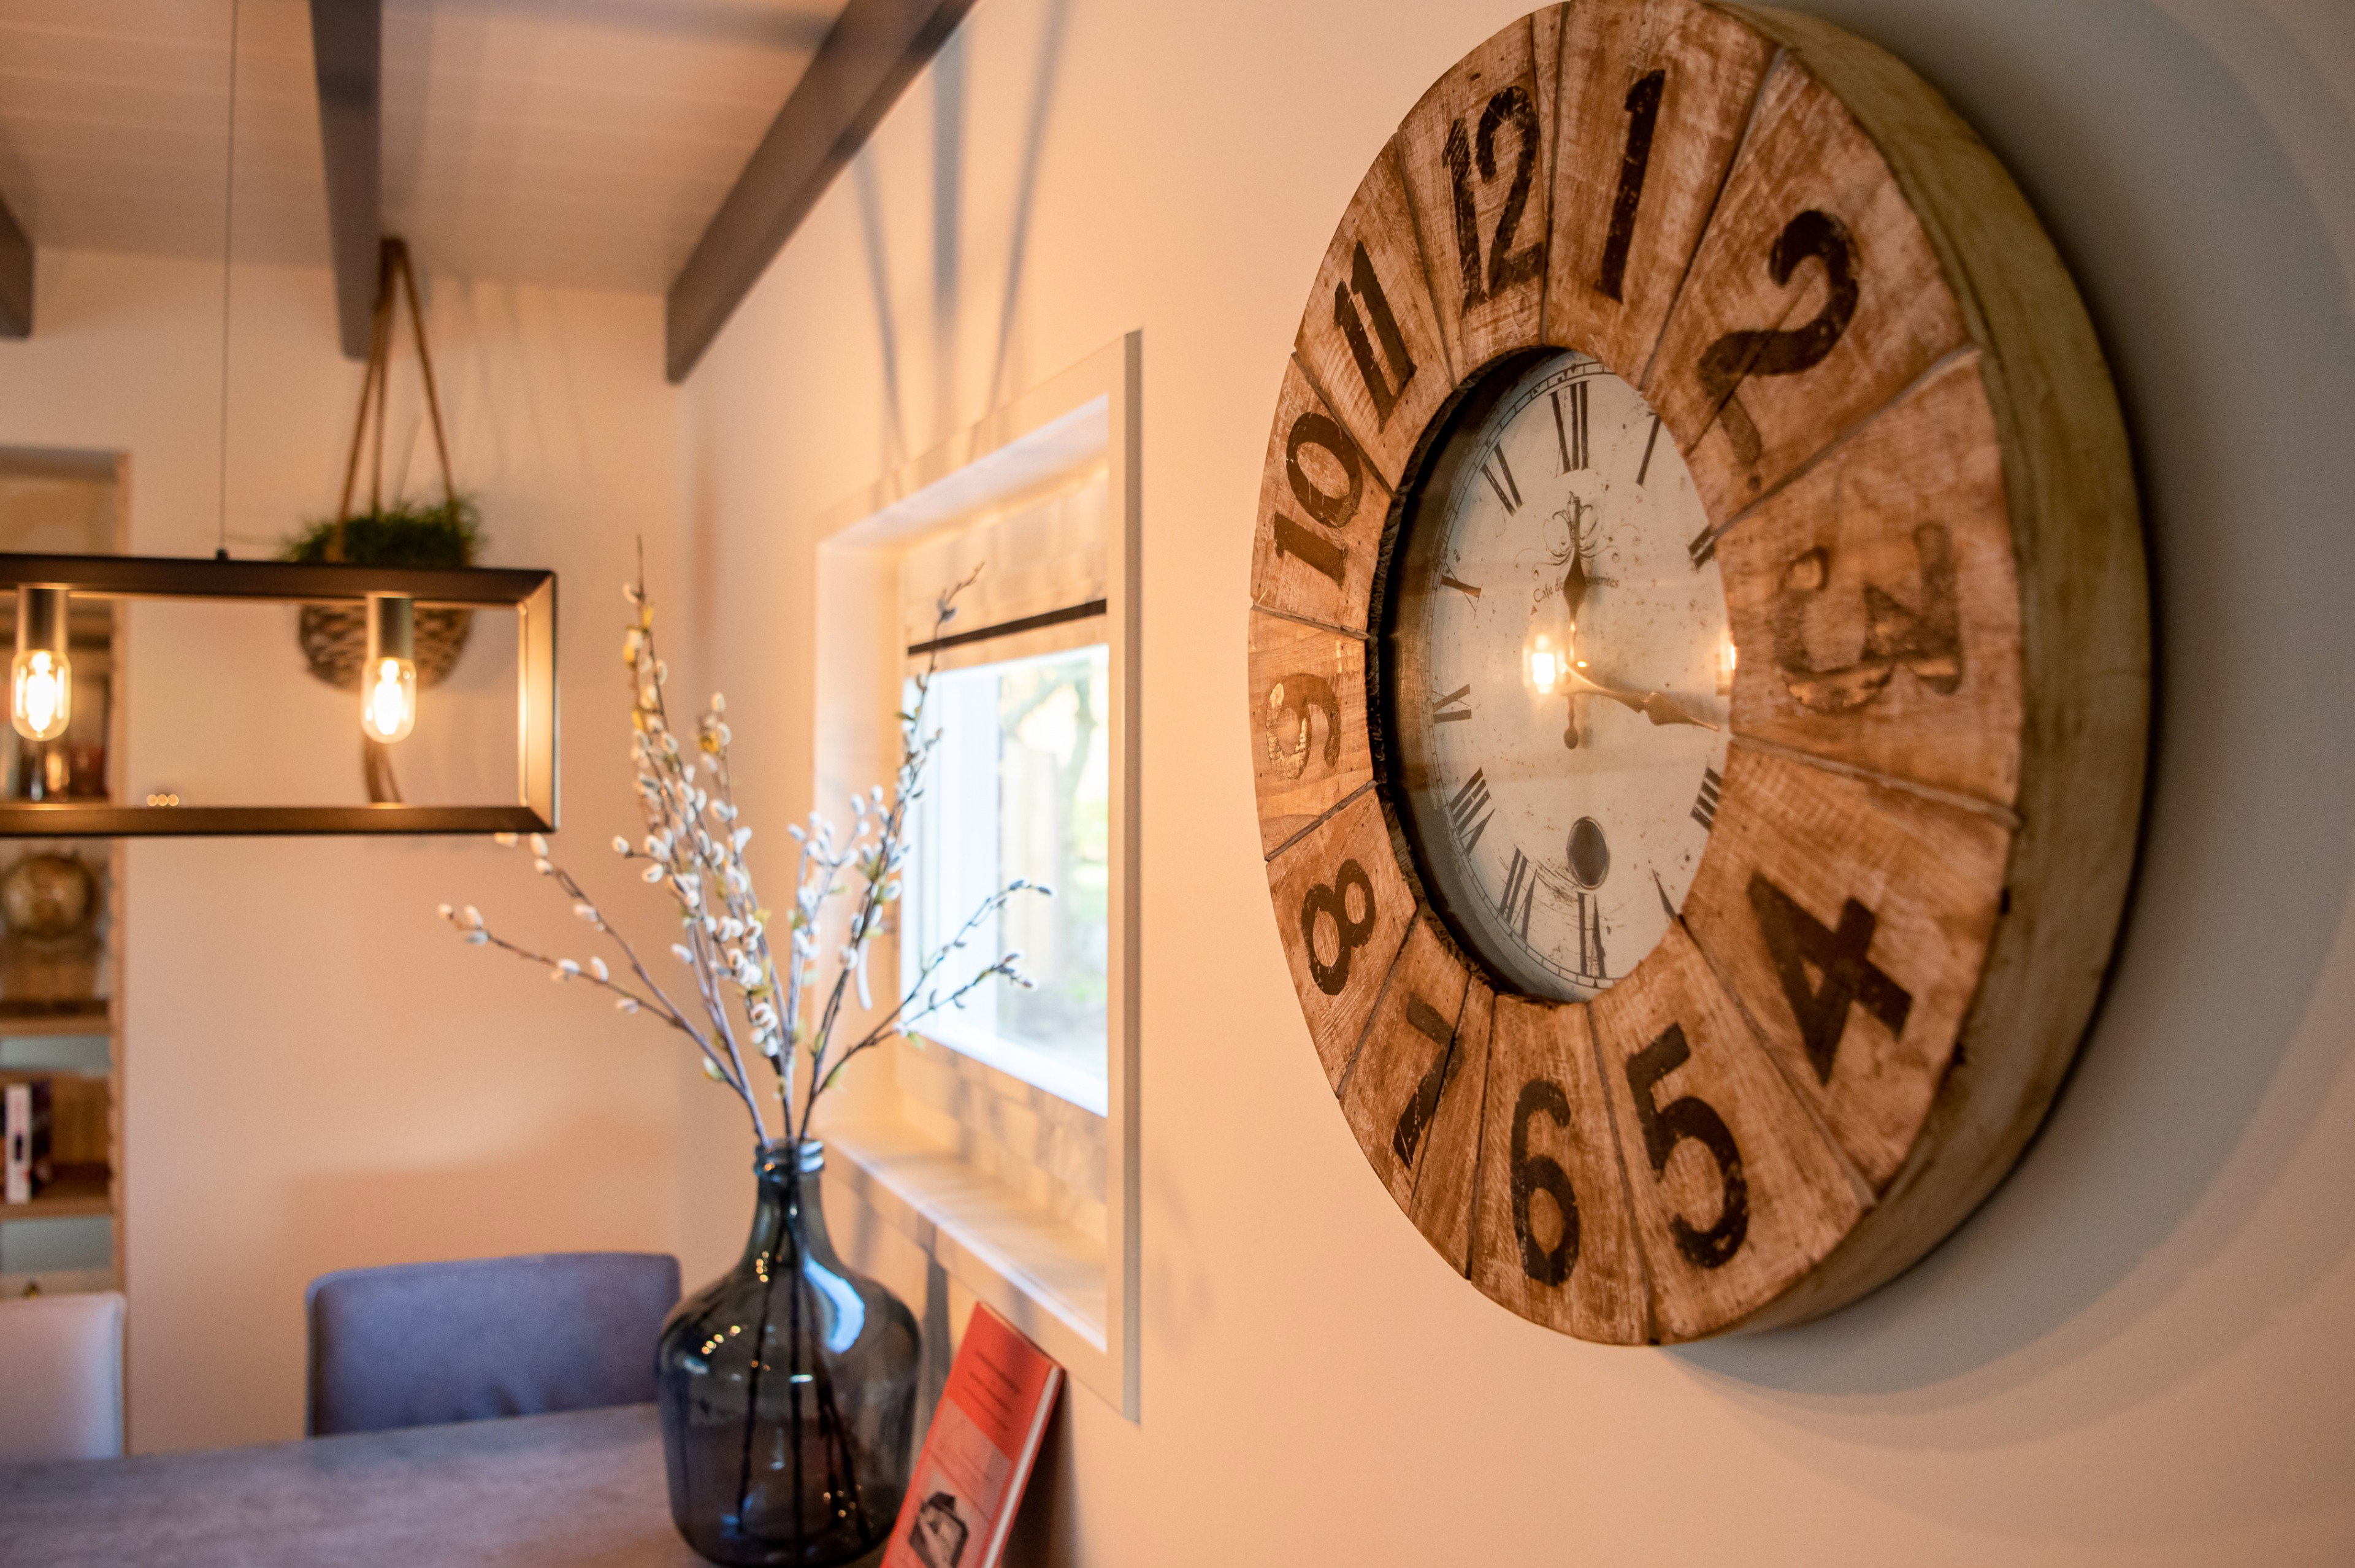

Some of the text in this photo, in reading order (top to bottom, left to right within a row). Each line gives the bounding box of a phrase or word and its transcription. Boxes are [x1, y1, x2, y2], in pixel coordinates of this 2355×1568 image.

[1441, 85, 1547, 319] 12
[1595, 69, 1666, 305] 1
[1333, 240, 1418, 433] 11
[1698, 208, 1861, 466] 2
[1273, 411, 1363, 590] 10
[1771, 520, 1962, 715] 3
[1265, 672, 1342, 781] 9
[1300, 859, 1377, 996] 8
[1745, 870, 1913, 1086] 4
[1392, 993, 1466, 1170] 7
[1626, 1021, 1749, 1269] 5
[1510, 1079, 1581, 1288] 6
